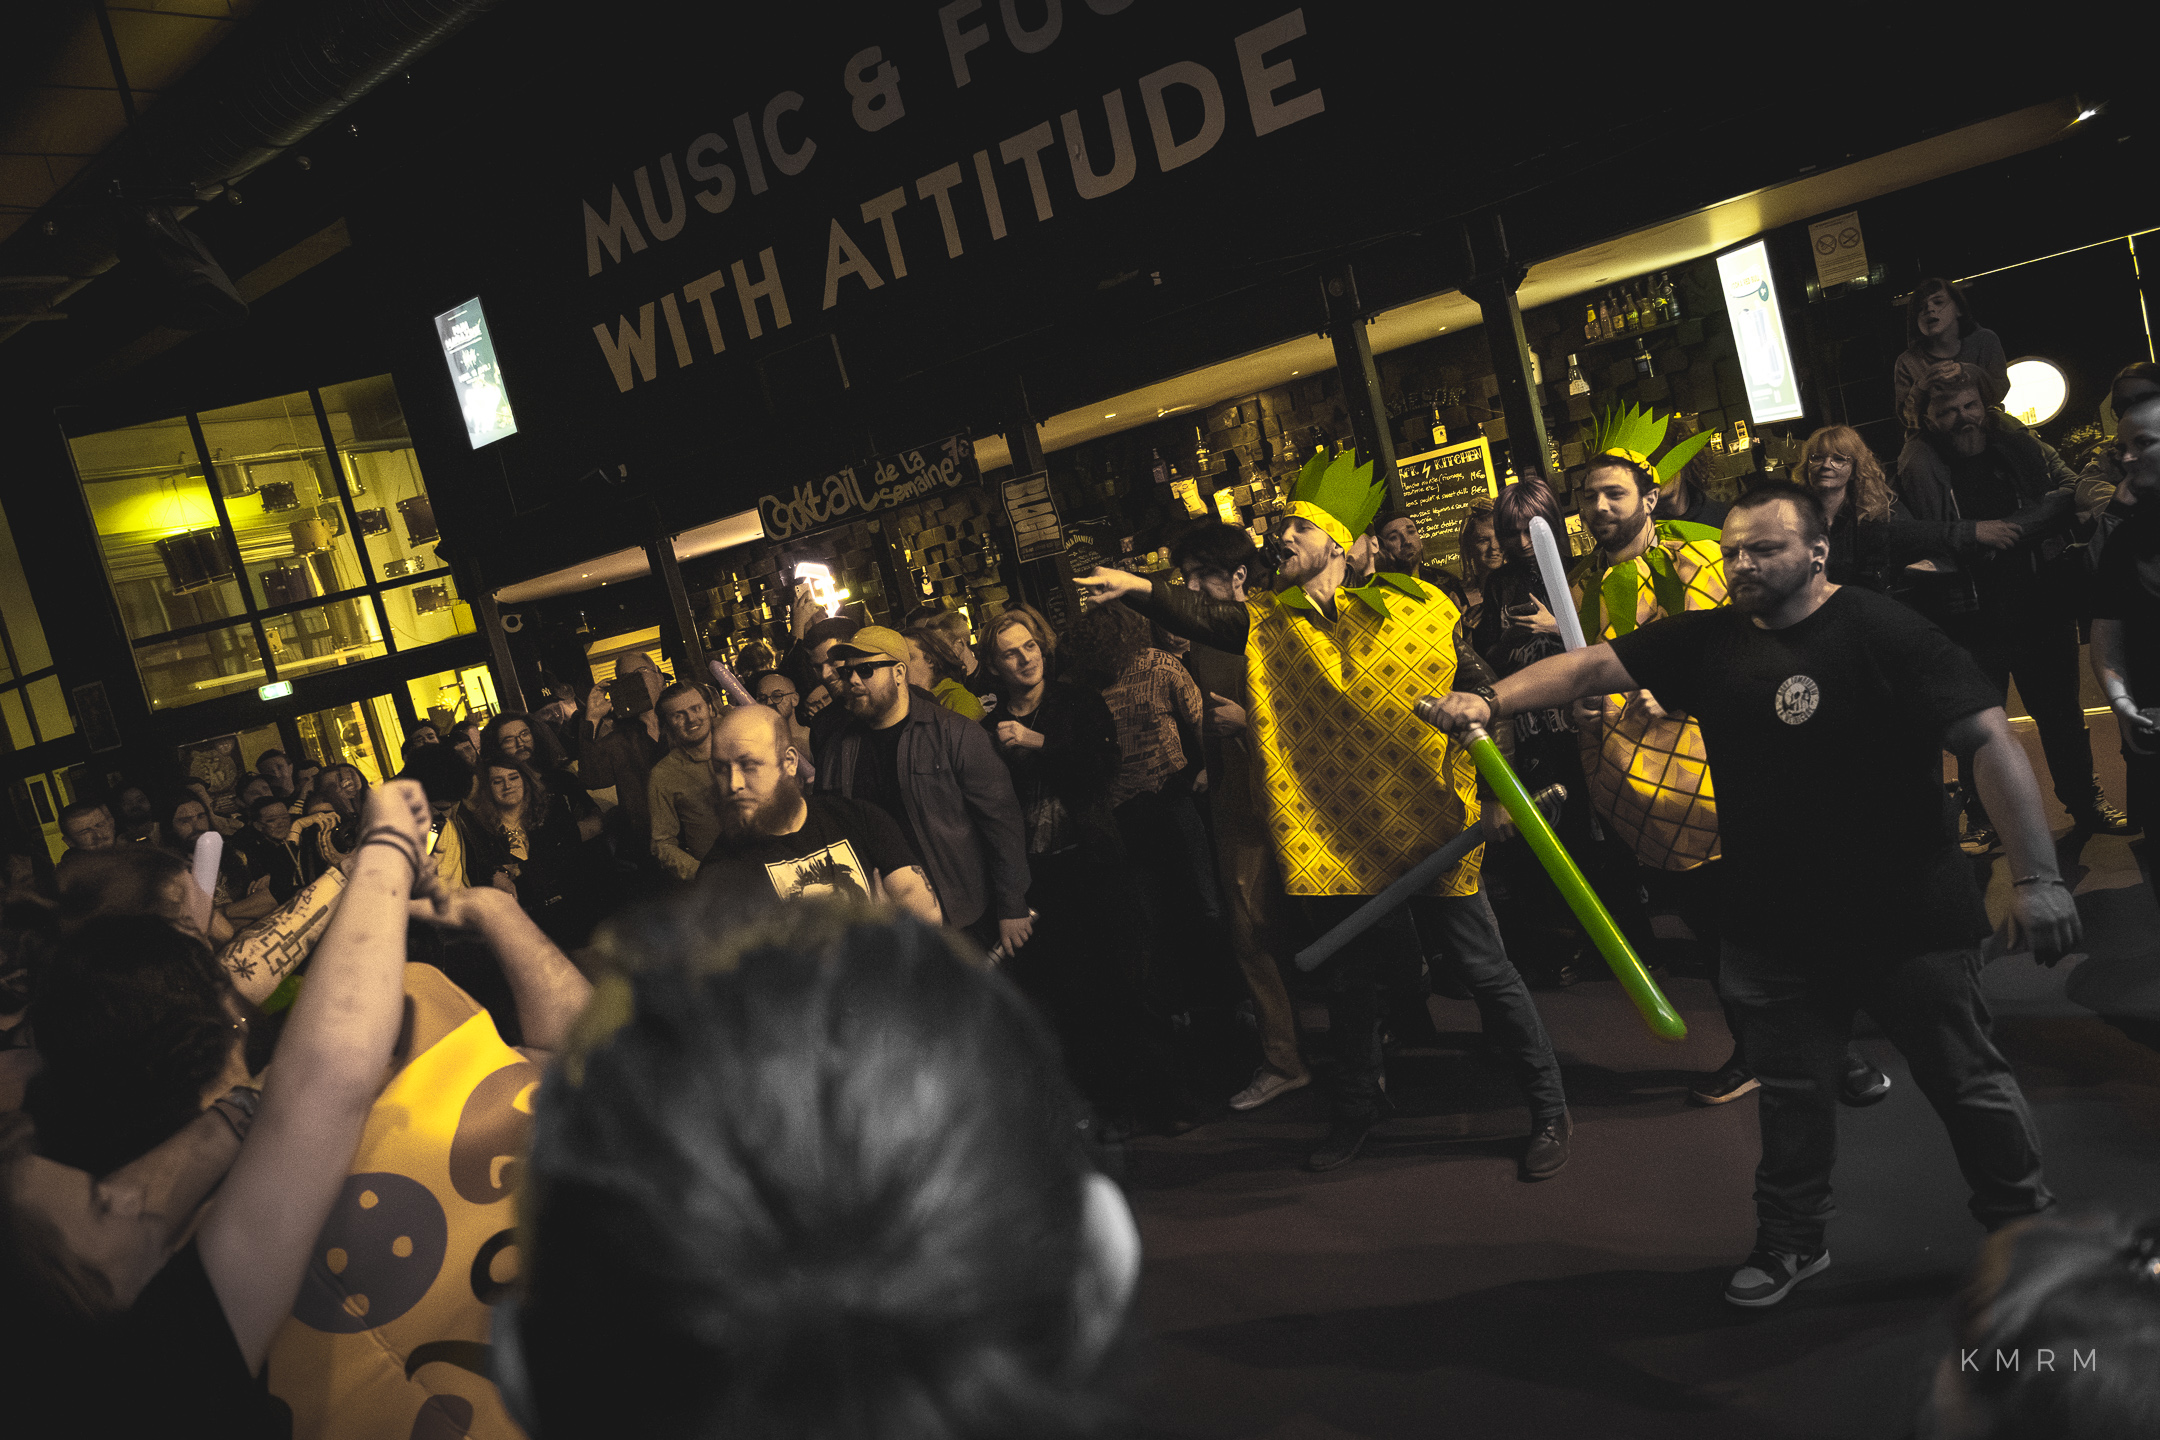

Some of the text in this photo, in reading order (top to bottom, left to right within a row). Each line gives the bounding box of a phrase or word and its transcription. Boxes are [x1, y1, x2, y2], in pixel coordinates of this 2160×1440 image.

[583, 0, 1135, 277] MUSIC & FO
[592, 8, 1326, 393] WITH ATTITUDE
[878, 456, 963, 508] semaine
[1433, 448, 1482, 471] KITCHEN
[758, 465, 881, 541] Cocktail
[874, 461, 900, 485] de
